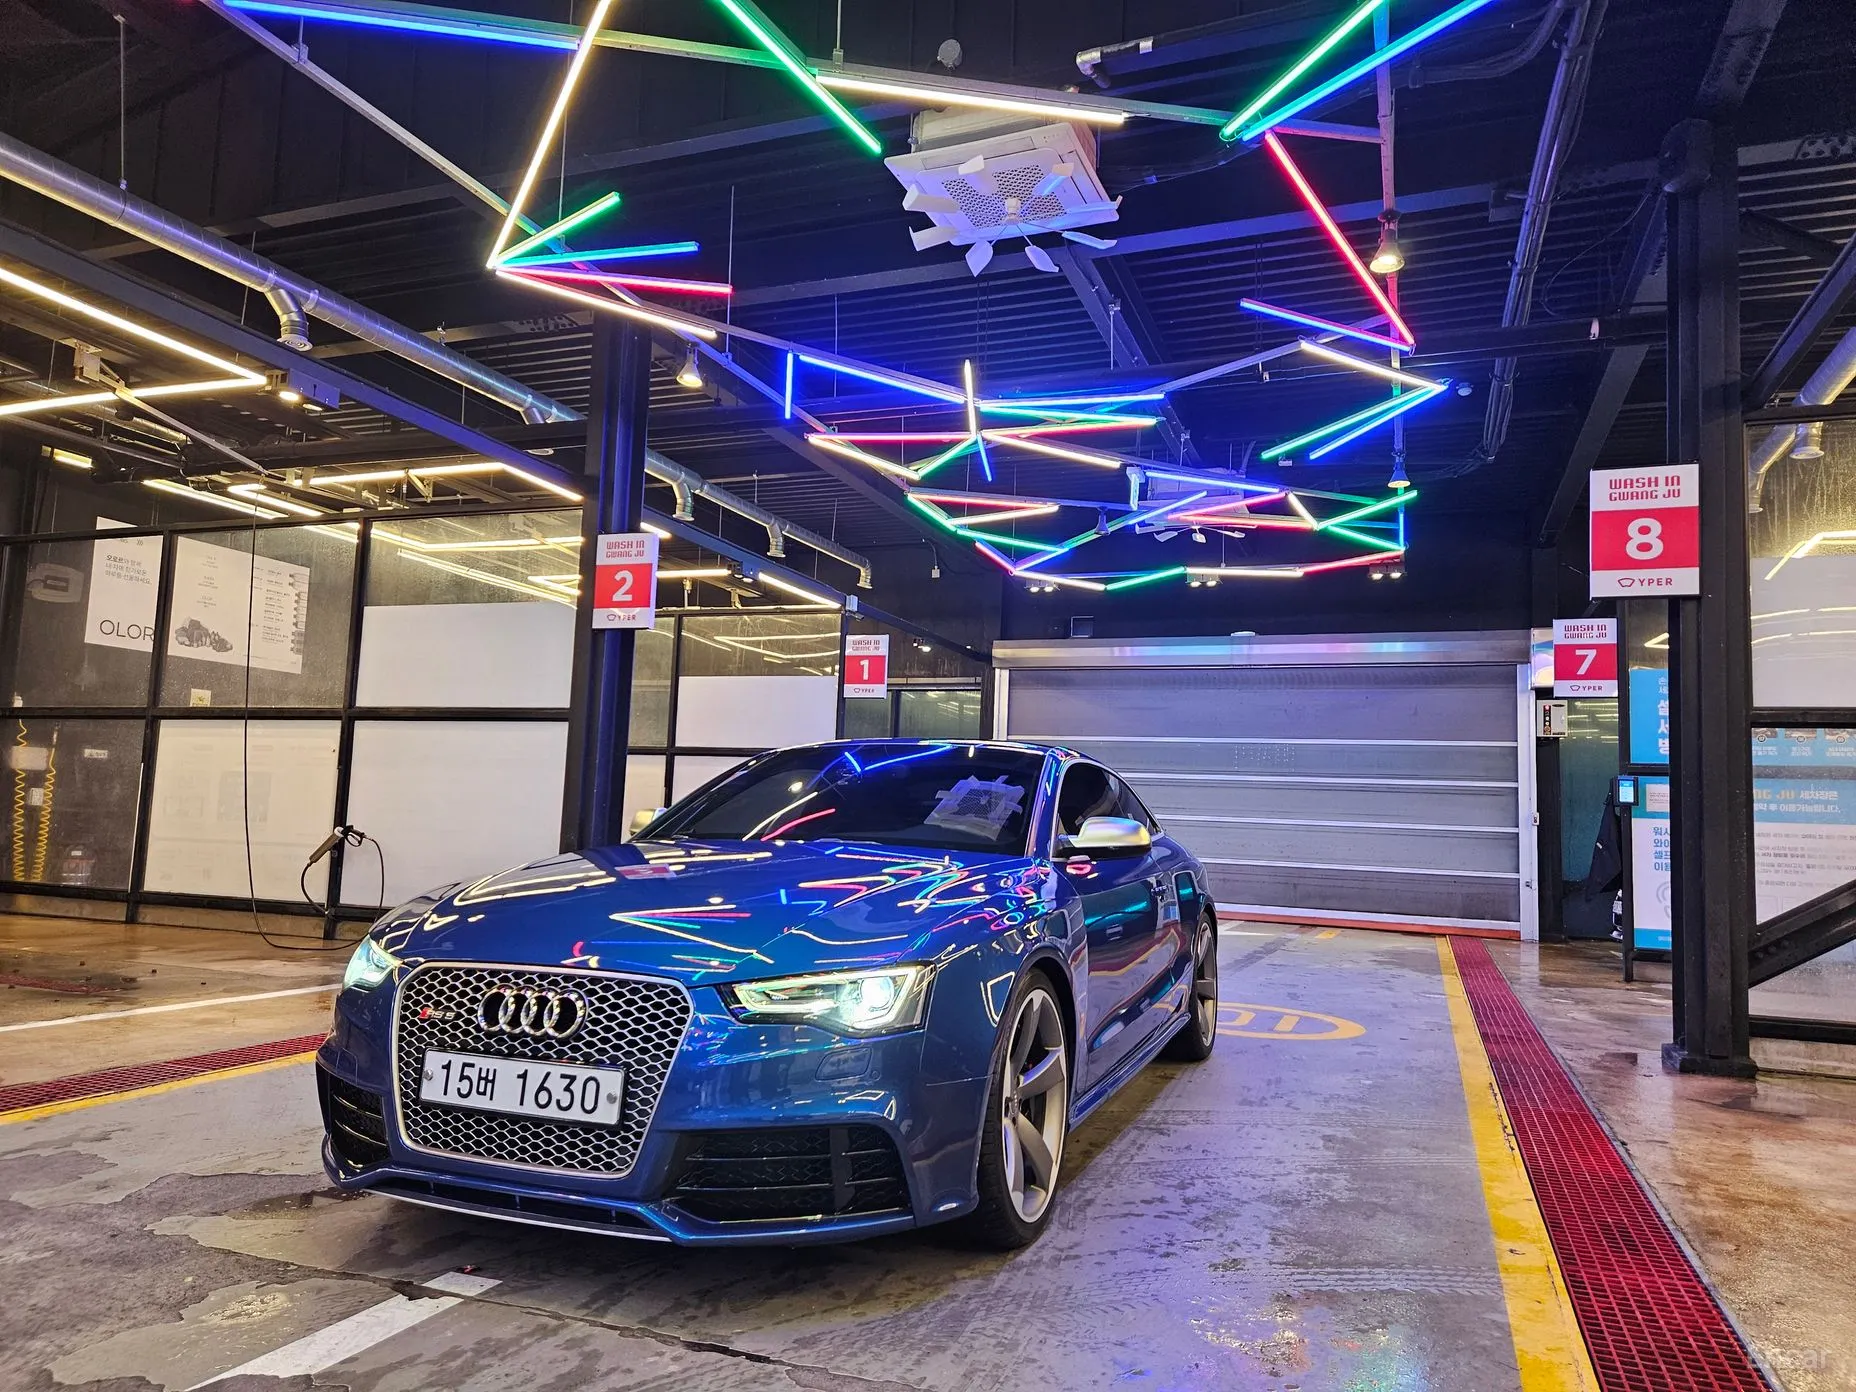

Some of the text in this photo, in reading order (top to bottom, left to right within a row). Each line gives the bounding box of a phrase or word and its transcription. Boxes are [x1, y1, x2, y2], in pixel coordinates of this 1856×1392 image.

[1609, 475, 1680, 489] WASH IN
[1609, 489, 1680, 501] GWANG JU
[607, 540, 645, 549] WASH IN
[1625, 517, 1664, 561] 8
[606, 550, 632, 558] GWANG
[611, 569, 633, 602] 2
[100, 619, 154, 641] OLOR
[859, 659, 869, 681] 1
[1575, 649, 1597, 675] 7
[441, 1059, 601, 1115] 15버 1630
